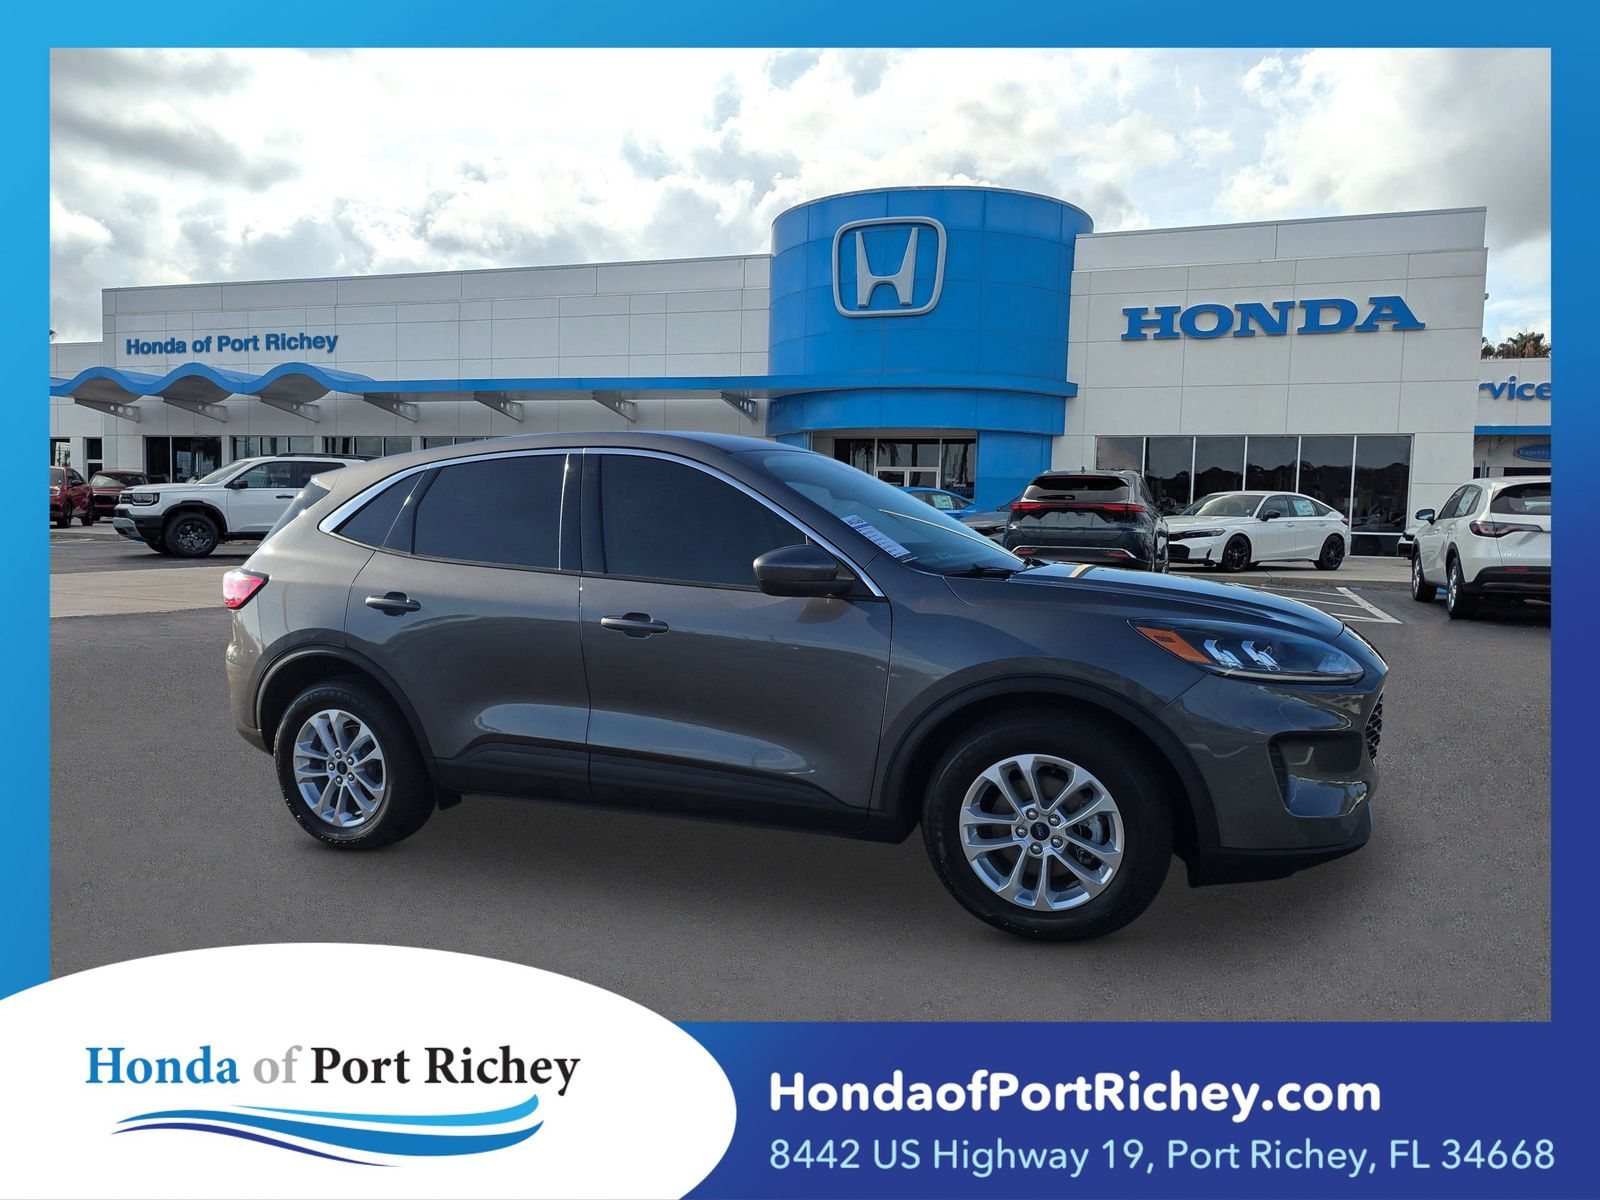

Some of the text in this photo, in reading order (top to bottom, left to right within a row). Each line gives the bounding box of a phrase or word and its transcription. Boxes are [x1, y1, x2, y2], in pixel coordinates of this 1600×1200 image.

[1121, 296, 1425, 341] HONDA
[126, 332, 339, 355] Honda of Port Richey
